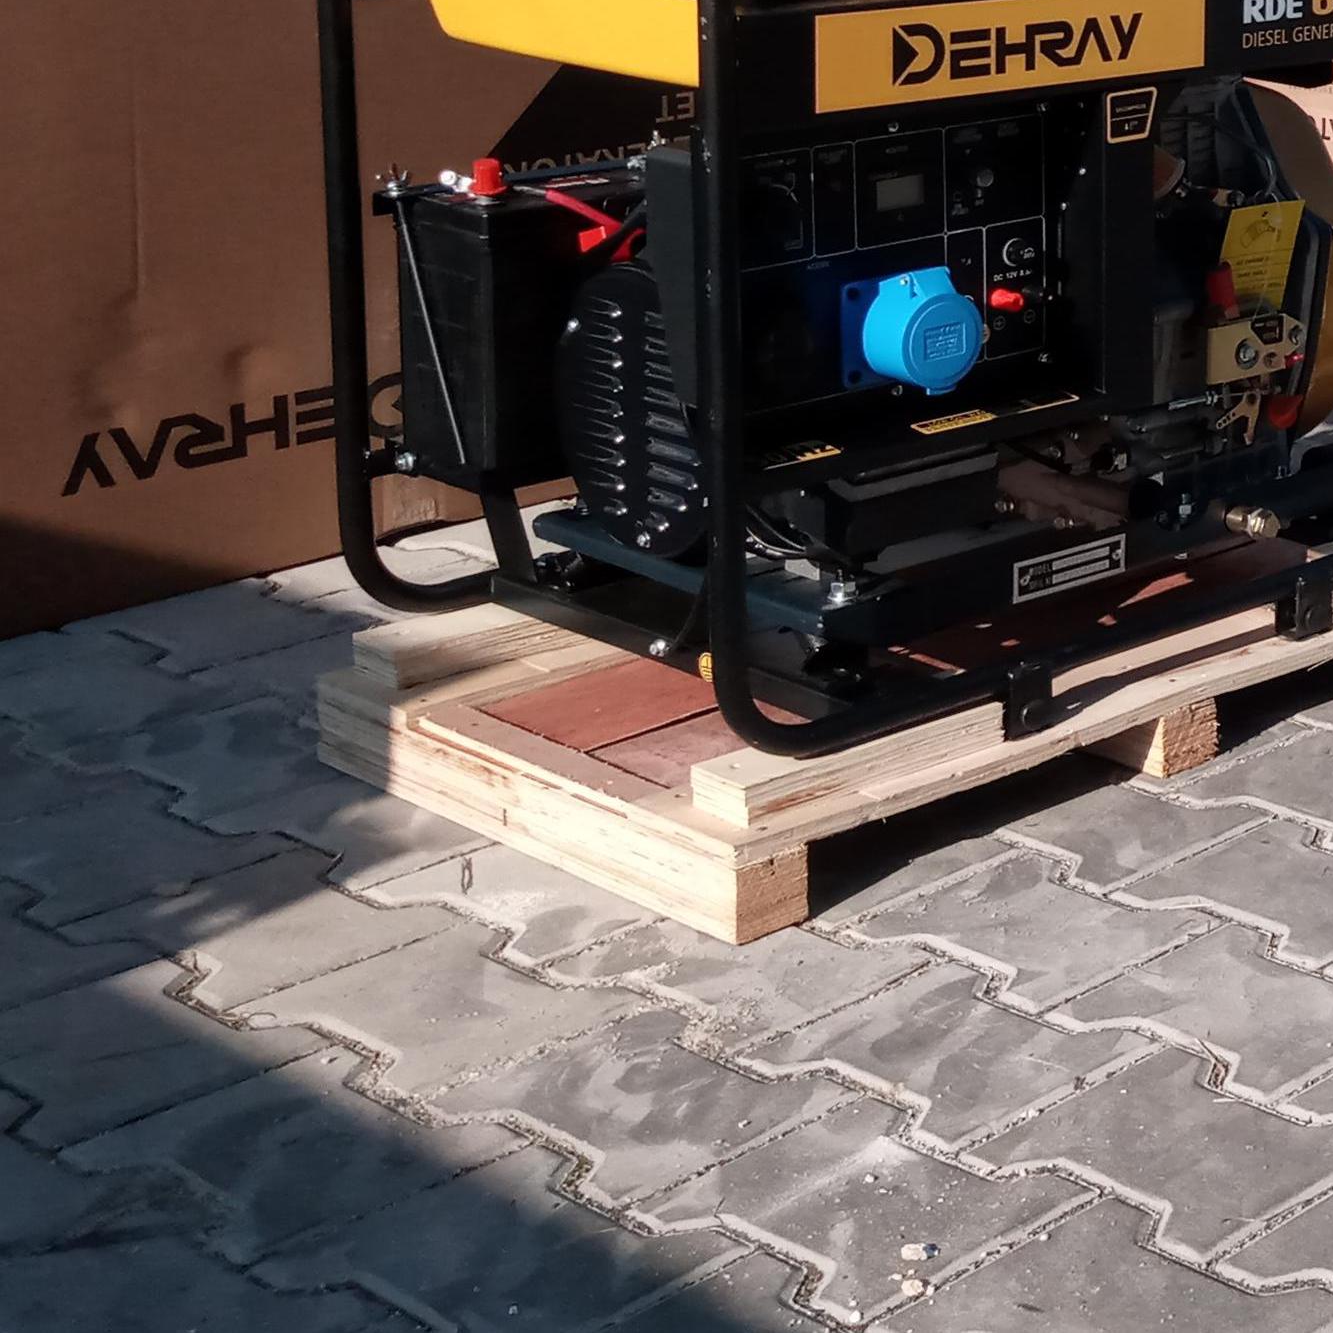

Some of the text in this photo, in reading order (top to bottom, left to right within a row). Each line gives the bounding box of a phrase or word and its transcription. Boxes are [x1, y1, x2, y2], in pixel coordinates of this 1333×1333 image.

[892, 12, 1144, 87] DEHRAY
[1242, 28, 1289, 49] DIESEL
[61, 371, 403, 497] DEHRAY
